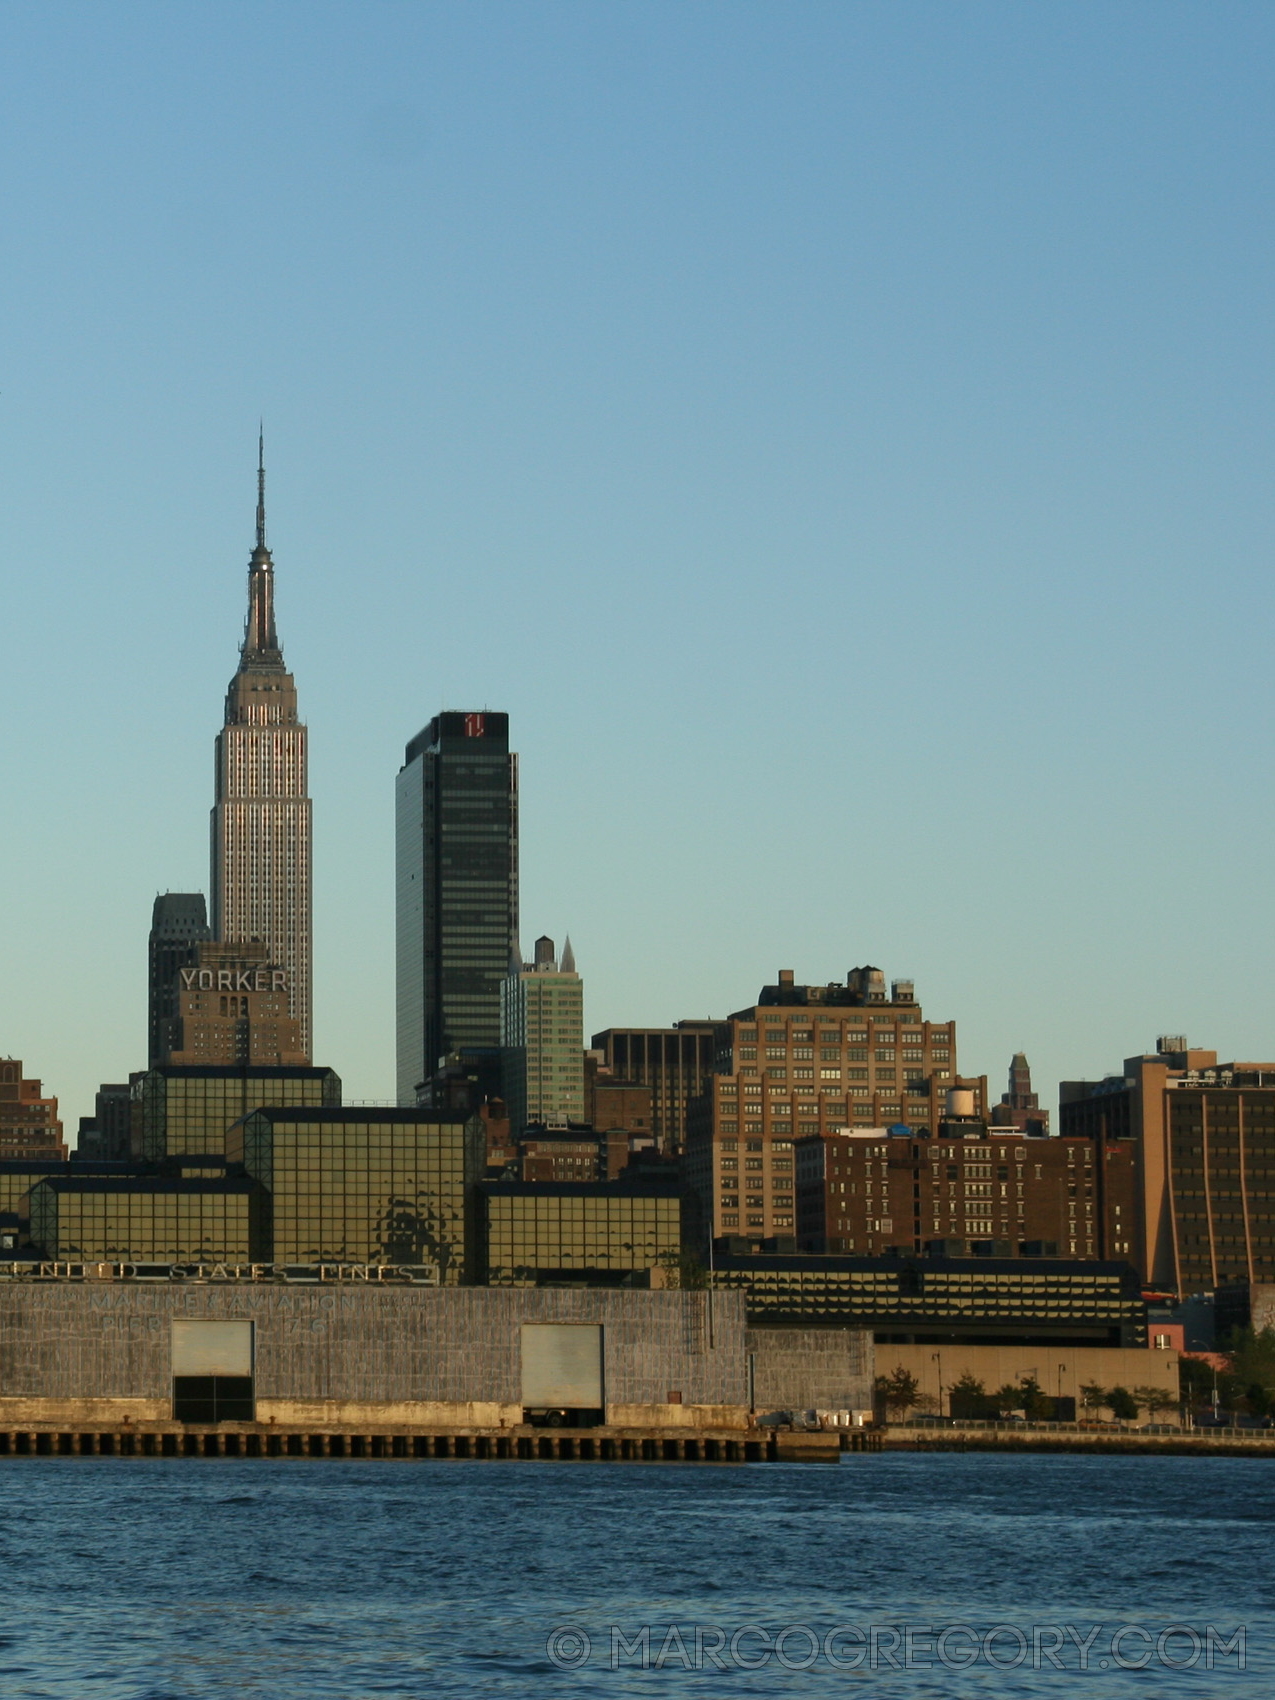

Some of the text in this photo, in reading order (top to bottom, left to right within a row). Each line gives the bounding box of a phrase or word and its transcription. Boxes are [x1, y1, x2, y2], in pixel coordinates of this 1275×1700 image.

[180, 969, 288, 992] YORKER
[170, 1263, 288, 1281] STATES
[320, 1264, 415, 1282] LINES
[89, 1294, 356, 1311] MARINE & AVIATION
[102, 1317, 162, 1332] PIER
